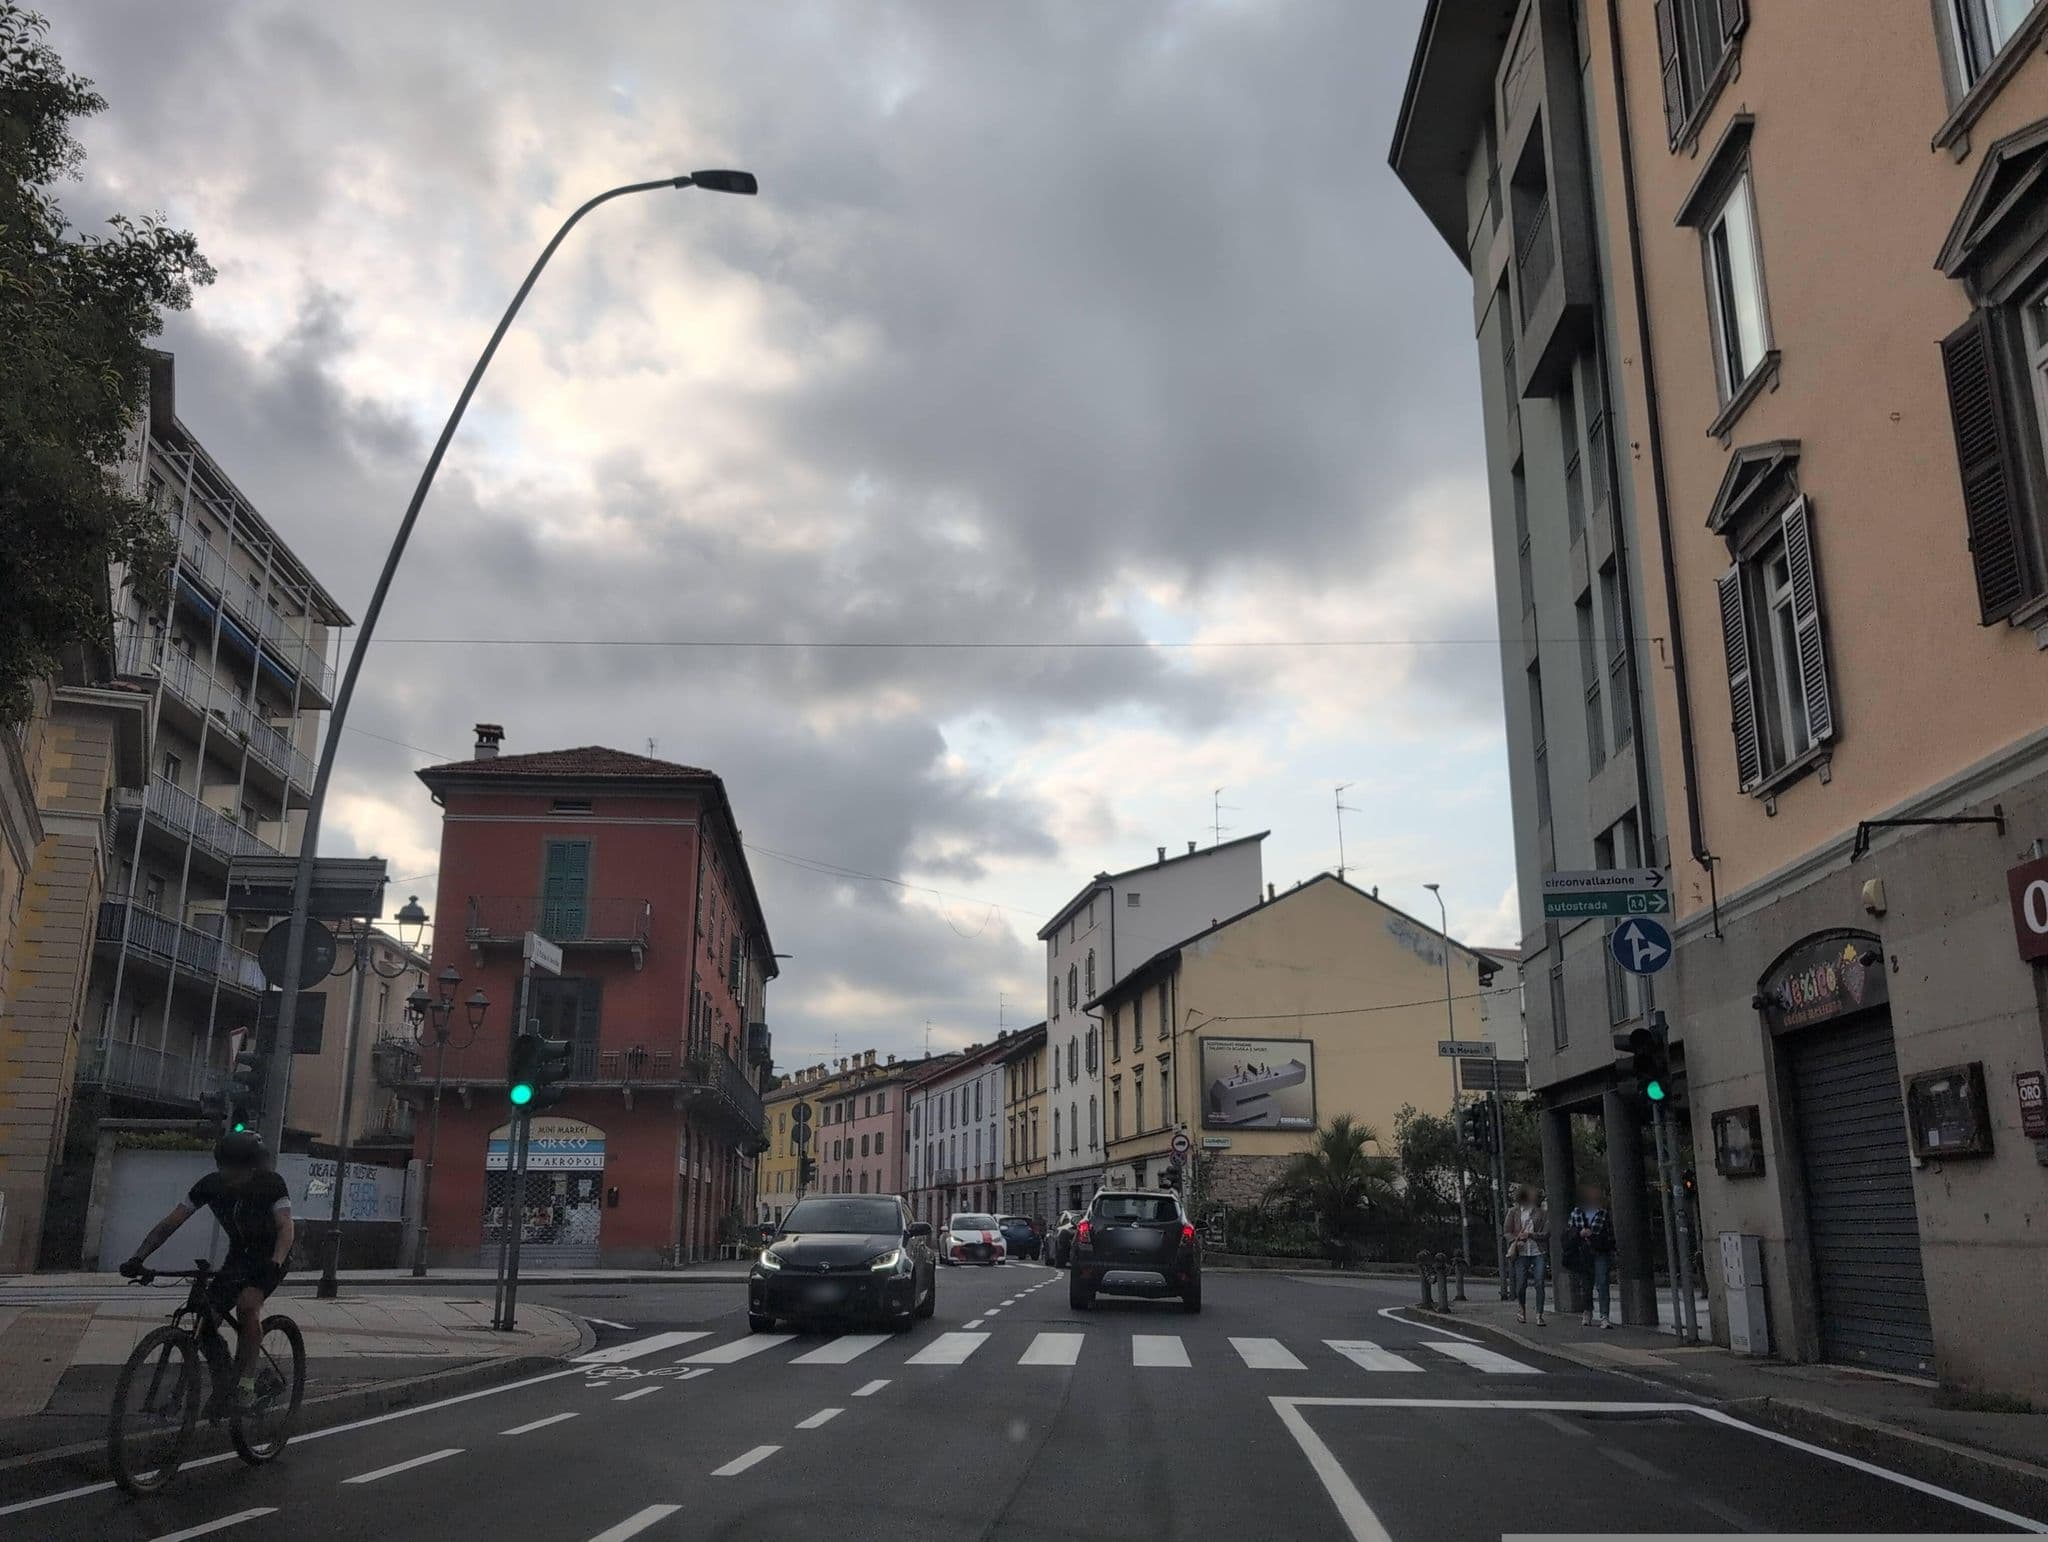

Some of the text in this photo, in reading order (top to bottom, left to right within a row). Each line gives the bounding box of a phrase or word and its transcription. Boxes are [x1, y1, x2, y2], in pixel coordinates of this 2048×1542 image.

[1546, 876, 1635, 888] circonvallazione
[1547, 901, 1608, 912] autostrada
[2020, 1084, 2041, 1101] ORO
[538, 1126, 589, 1134] MINI MARKET
[539, 1137, 588, 1149] GRECO
